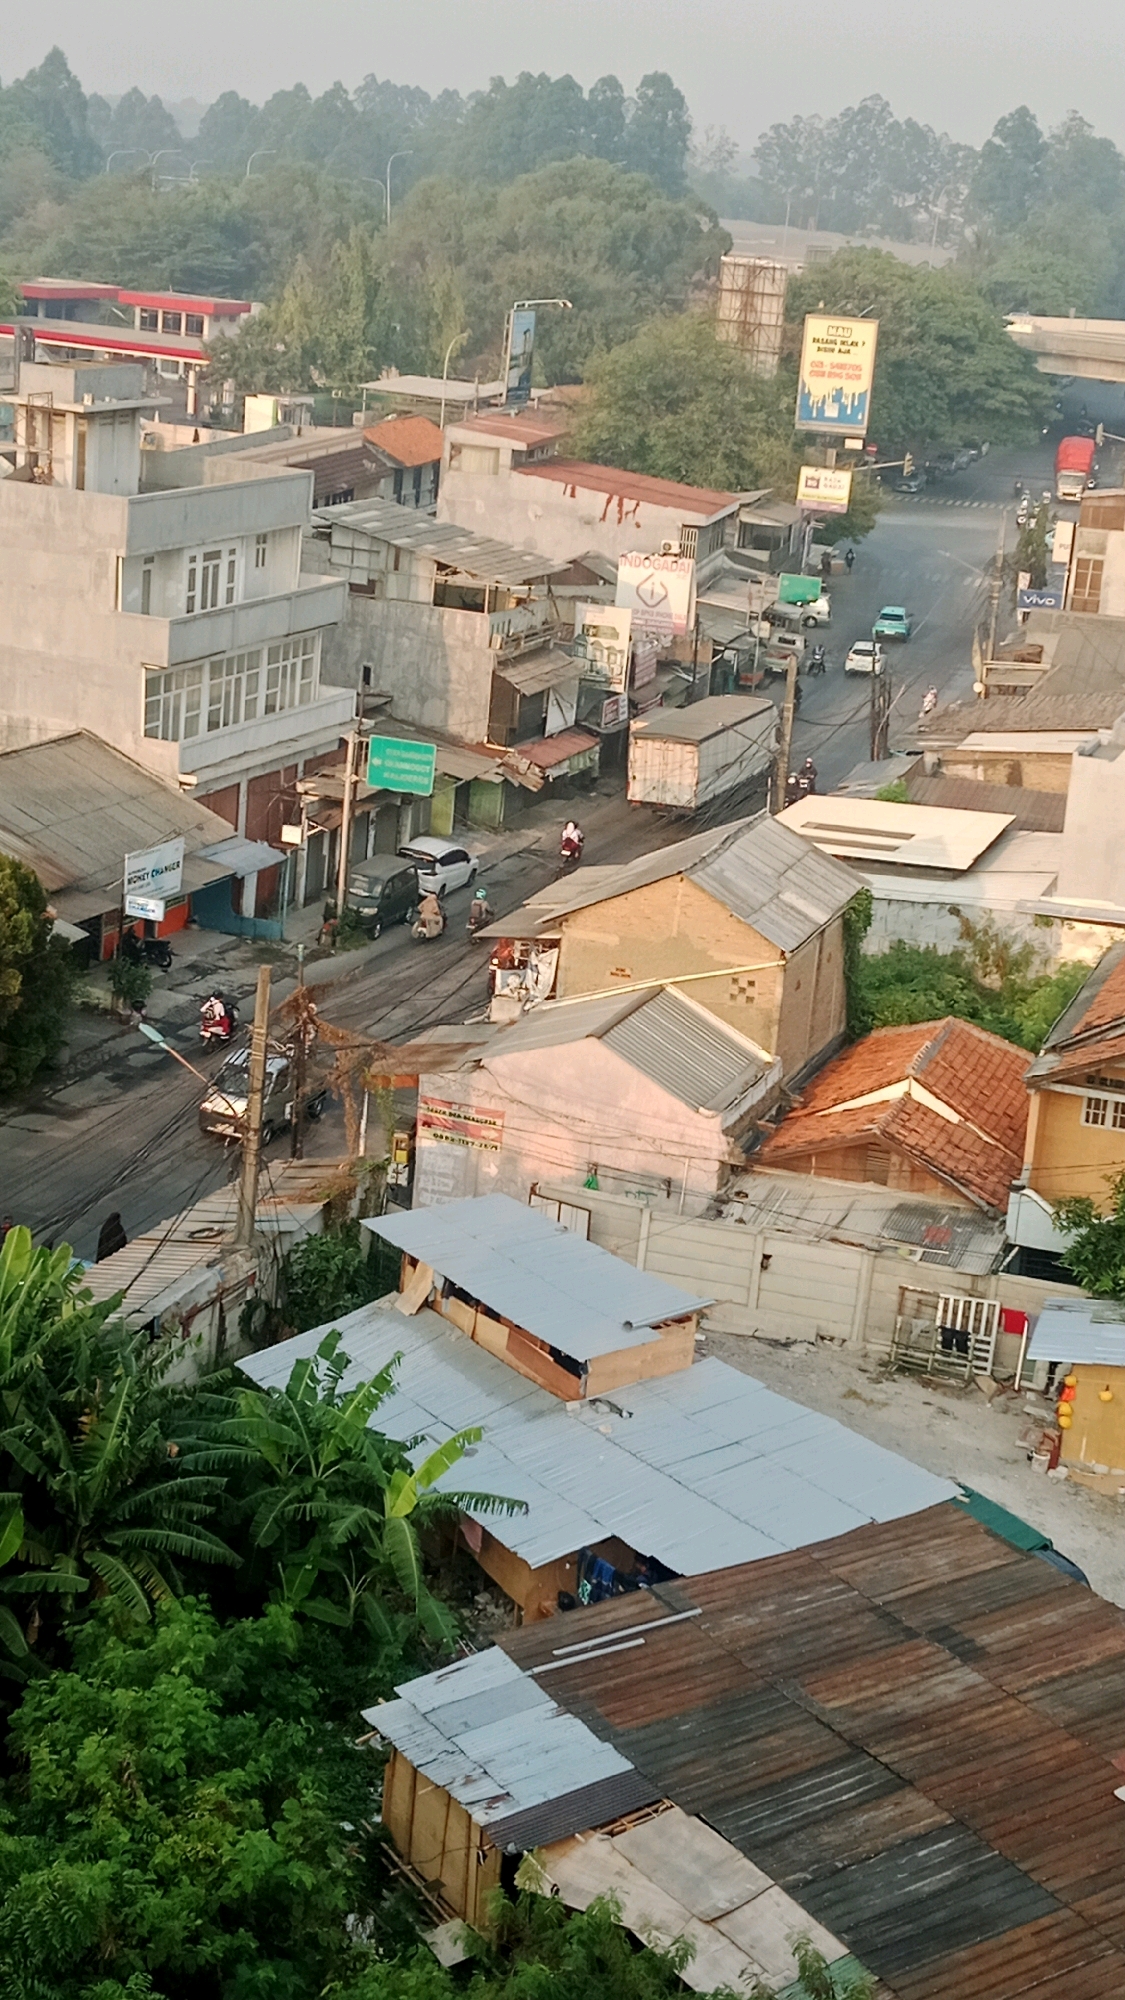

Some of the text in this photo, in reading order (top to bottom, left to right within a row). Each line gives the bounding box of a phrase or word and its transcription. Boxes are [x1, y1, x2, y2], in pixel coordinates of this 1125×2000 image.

[827, 325, 852, 338] MAU
[1023, 594, 1055, 606] vivo
[127, 860, 181, 886] MONEY CHANGER
